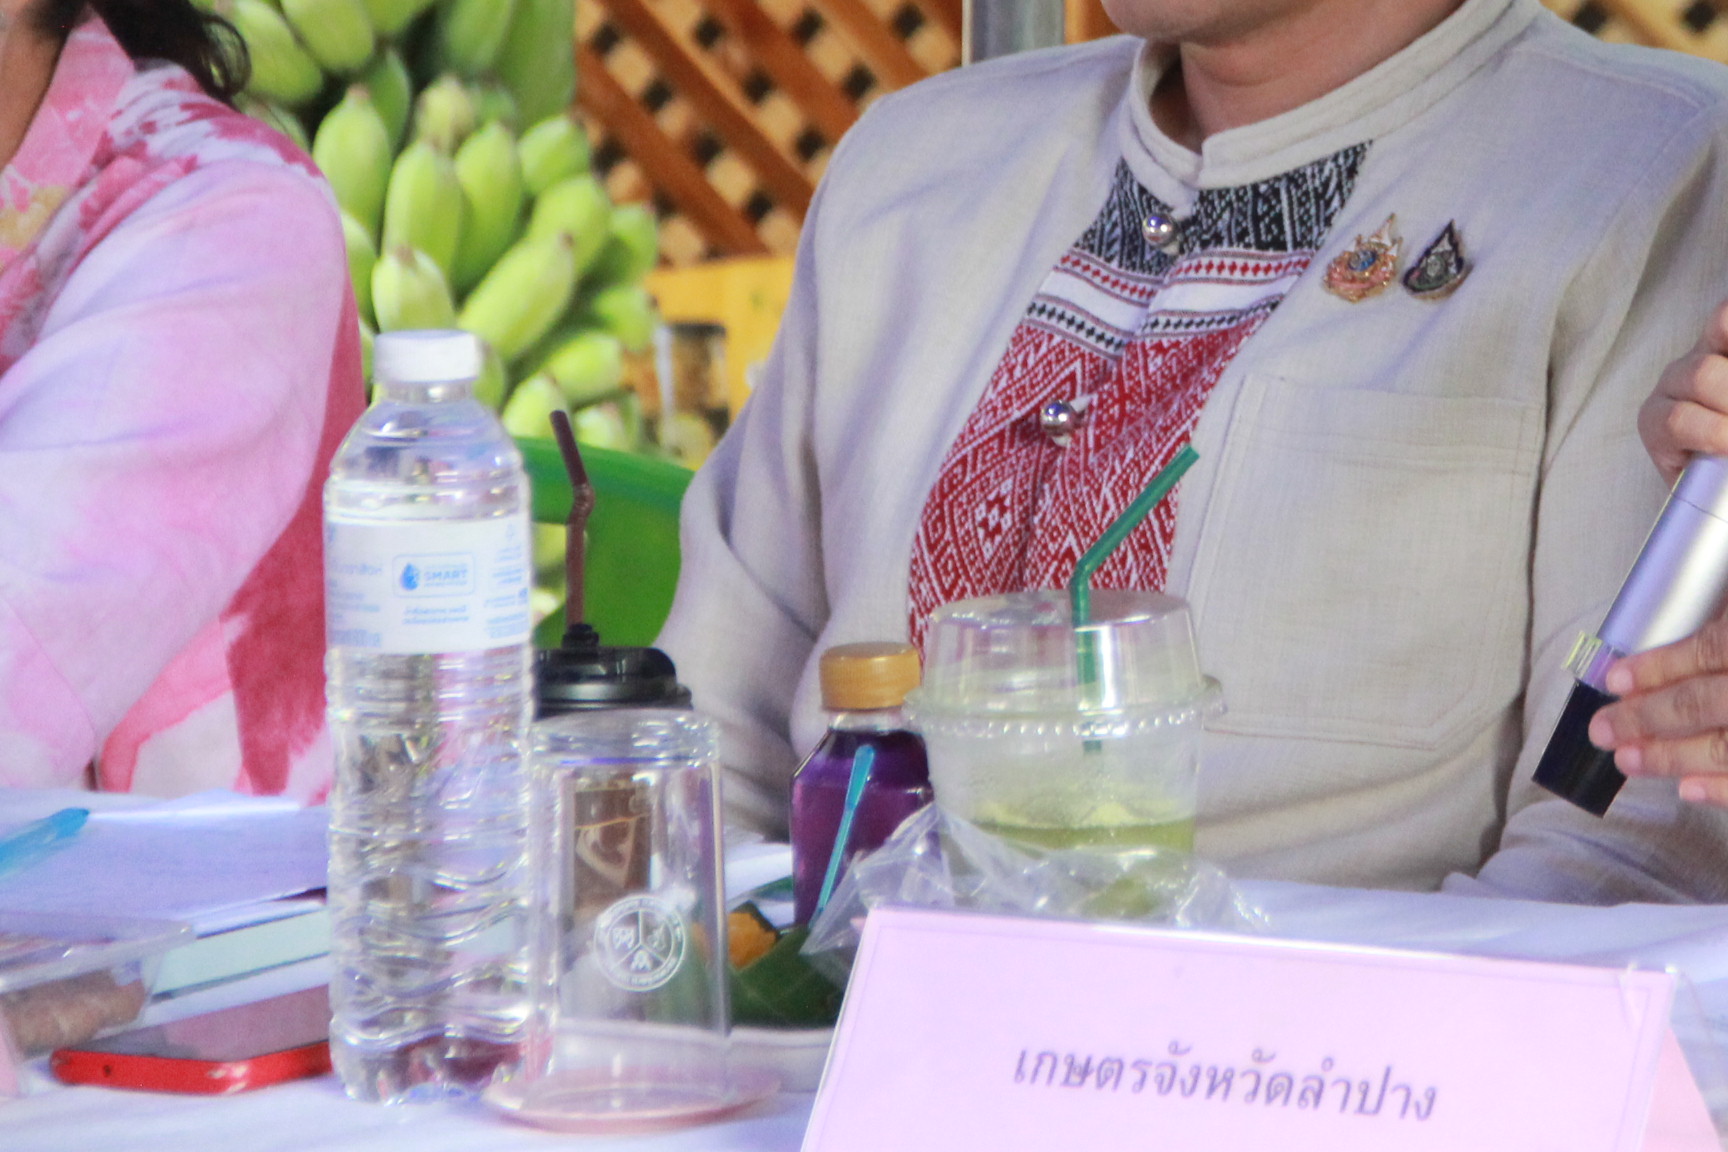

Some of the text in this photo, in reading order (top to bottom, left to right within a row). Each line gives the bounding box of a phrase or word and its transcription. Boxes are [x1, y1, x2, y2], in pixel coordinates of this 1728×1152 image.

[423, 568, 469, 581] SMART
[1013, 1039, 1438, 1121] เกษตรจังหวัดลำปาง
